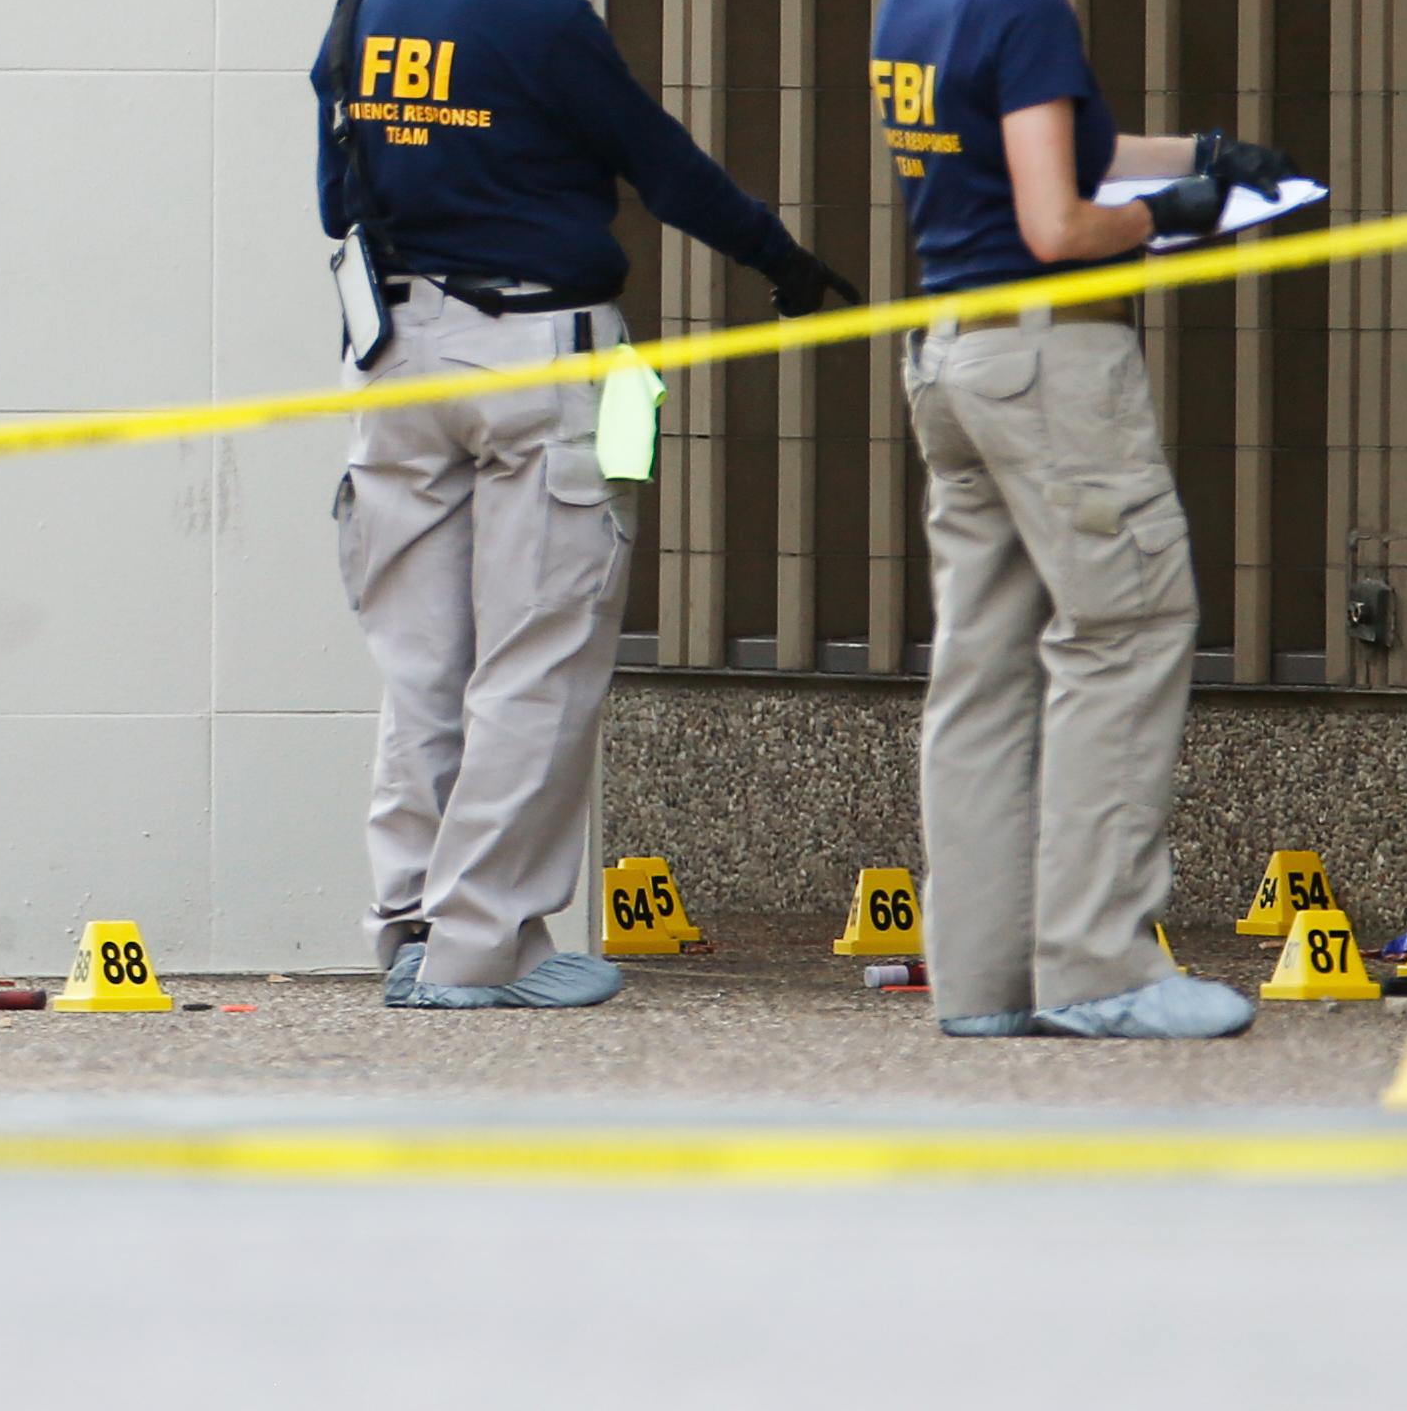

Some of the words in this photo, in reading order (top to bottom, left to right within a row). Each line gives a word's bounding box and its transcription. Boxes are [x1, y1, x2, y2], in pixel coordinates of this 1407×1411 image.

[359, 36, 455, 101] FBI
[869, 59, 937, 126] FBI
[385, 125, 429, 146] TEAM
[613, 888, 655, 930] 64
[651, 875, 674, 917] 5
[870, 889, 913, 931] 66
[1288, 872, 1329, 911] 54
[101, 941, 148, 985] 88
[1308, 929, 1350, 974] 87
